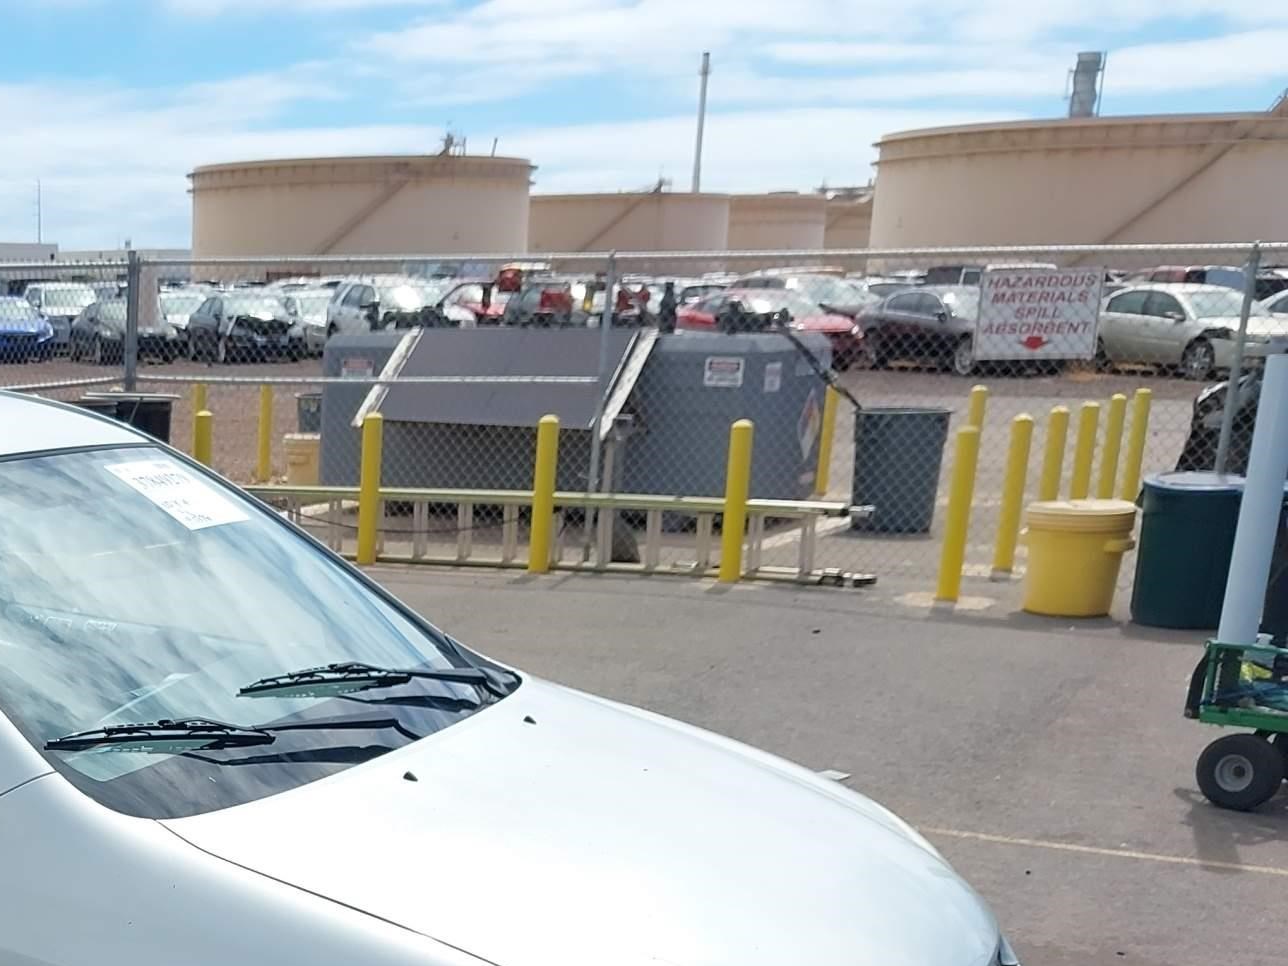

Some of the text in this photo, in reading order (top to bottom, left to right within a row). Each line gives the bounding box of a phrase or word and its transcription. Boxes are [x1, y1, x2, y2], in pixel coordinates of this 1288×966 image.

[988, 274, 1098, 288] HAZARDOUS
[991, 290, 1089, 304] MATERIALS
[1014, 306, 1060, 320] SPILL
[983, 321, 1091, 335] ABSORBENT
